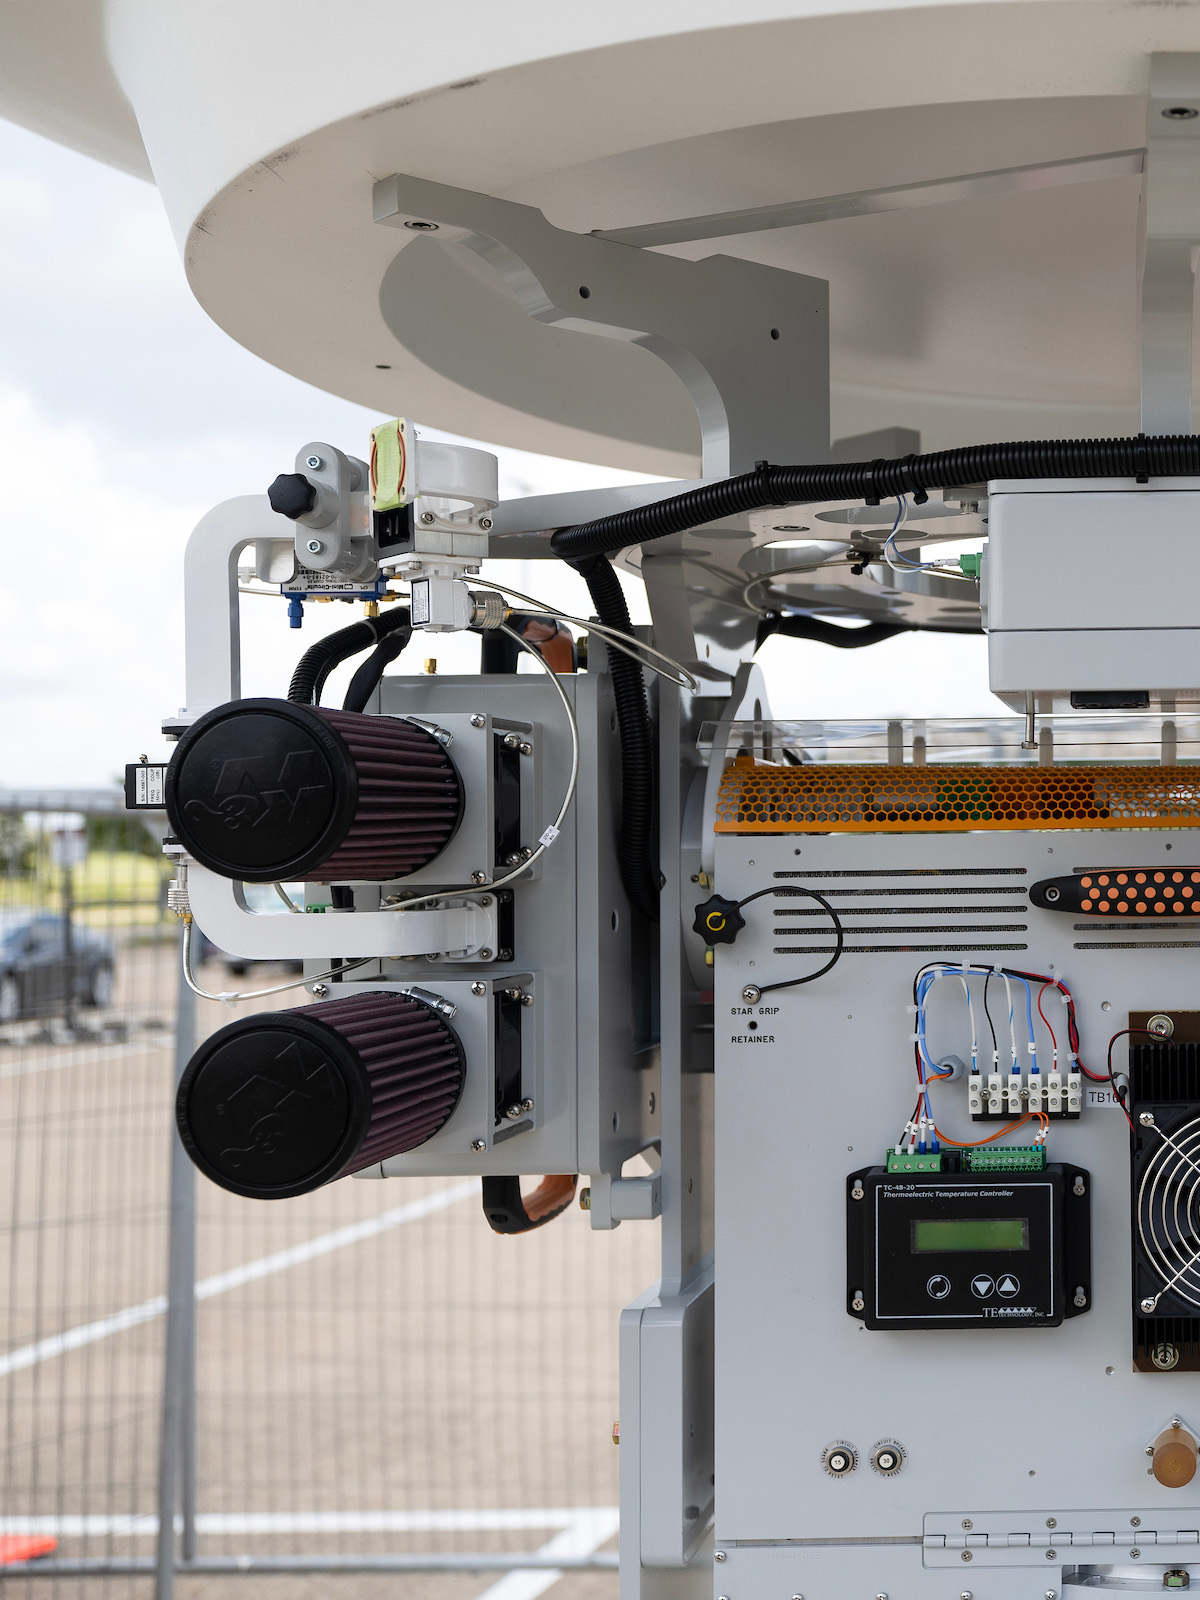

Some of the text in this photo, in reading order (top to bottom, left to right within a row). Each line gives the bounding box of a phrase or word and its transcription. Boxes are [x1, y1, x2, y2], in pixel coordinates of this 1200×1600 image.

[731, 1007, 780, 1015] STAR GRIP
[731, 1035, 775, 1043] RETAINER
[883, 1190, 1014, 1198] Thermoelectric Temperature Controller
[982, 1307, 999, 1318] TE
[836, 1440, 860, 1471] CIRCUIT BREAKER
[874, 1439, 907, 1458] CIRCUIT BREAKER
[820, 1447, 829, 1463] PRESS
[828, 1471, 844, 1479] RESET
[869, 1457, 878, 1473] PRESS
[887, 1468, 902, 1478] RESET
